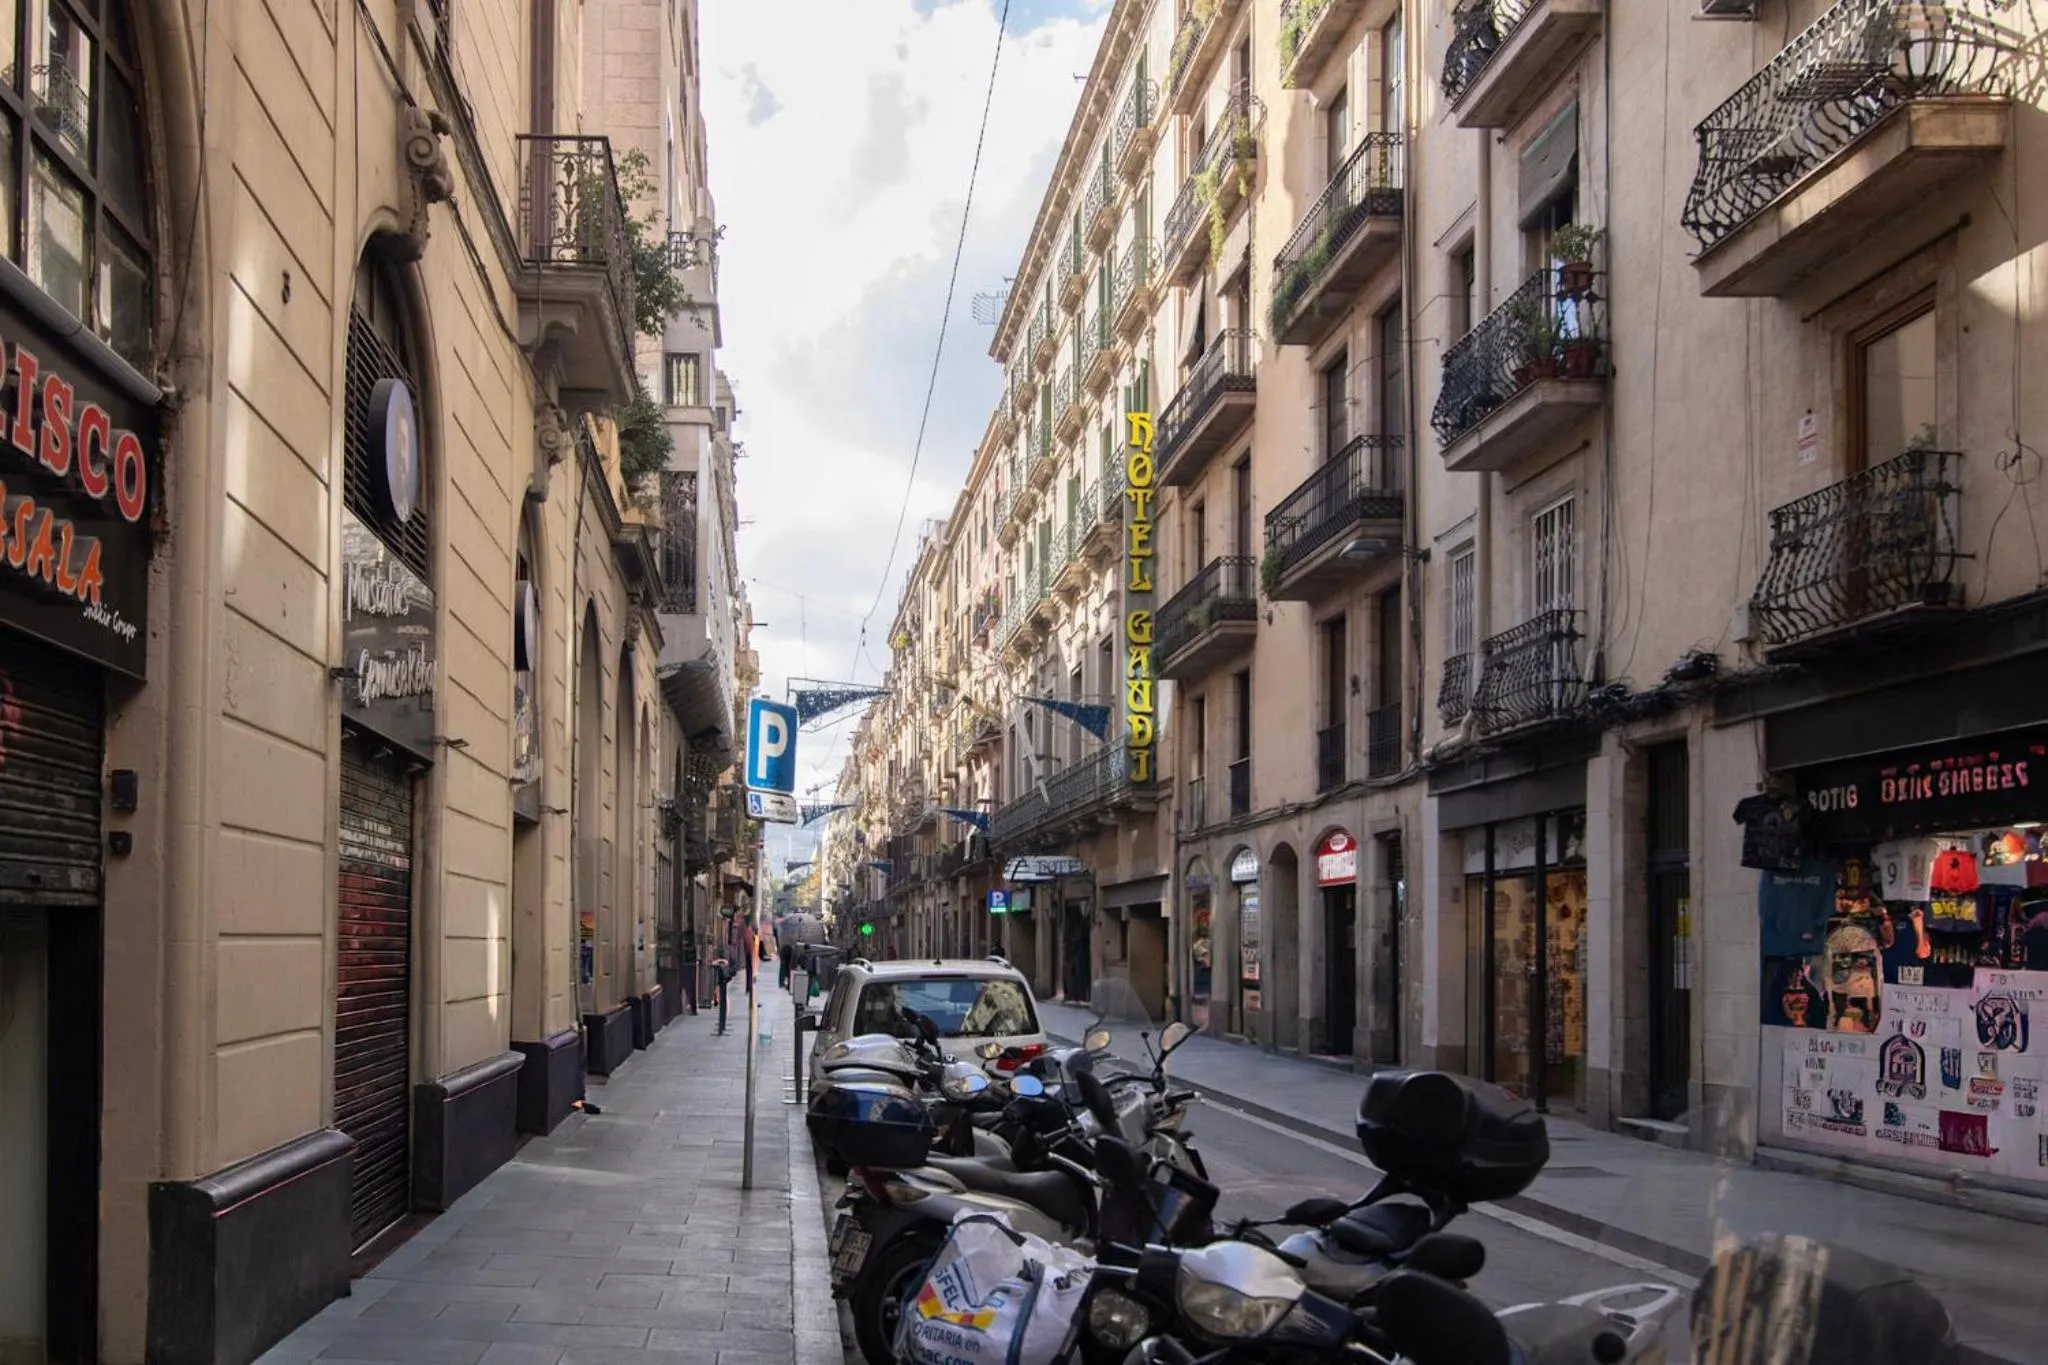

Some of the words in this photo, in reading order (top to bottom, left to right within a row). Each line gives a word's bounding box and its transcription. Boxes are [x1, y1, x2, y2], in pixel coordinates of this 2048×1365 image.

[0, 335, 146, 523] ISCO
[1125, 411, 1153, 593] HOTEL
[757, 709, 788, 779] P
[1126, 608, 1153, 784] GAUDI
